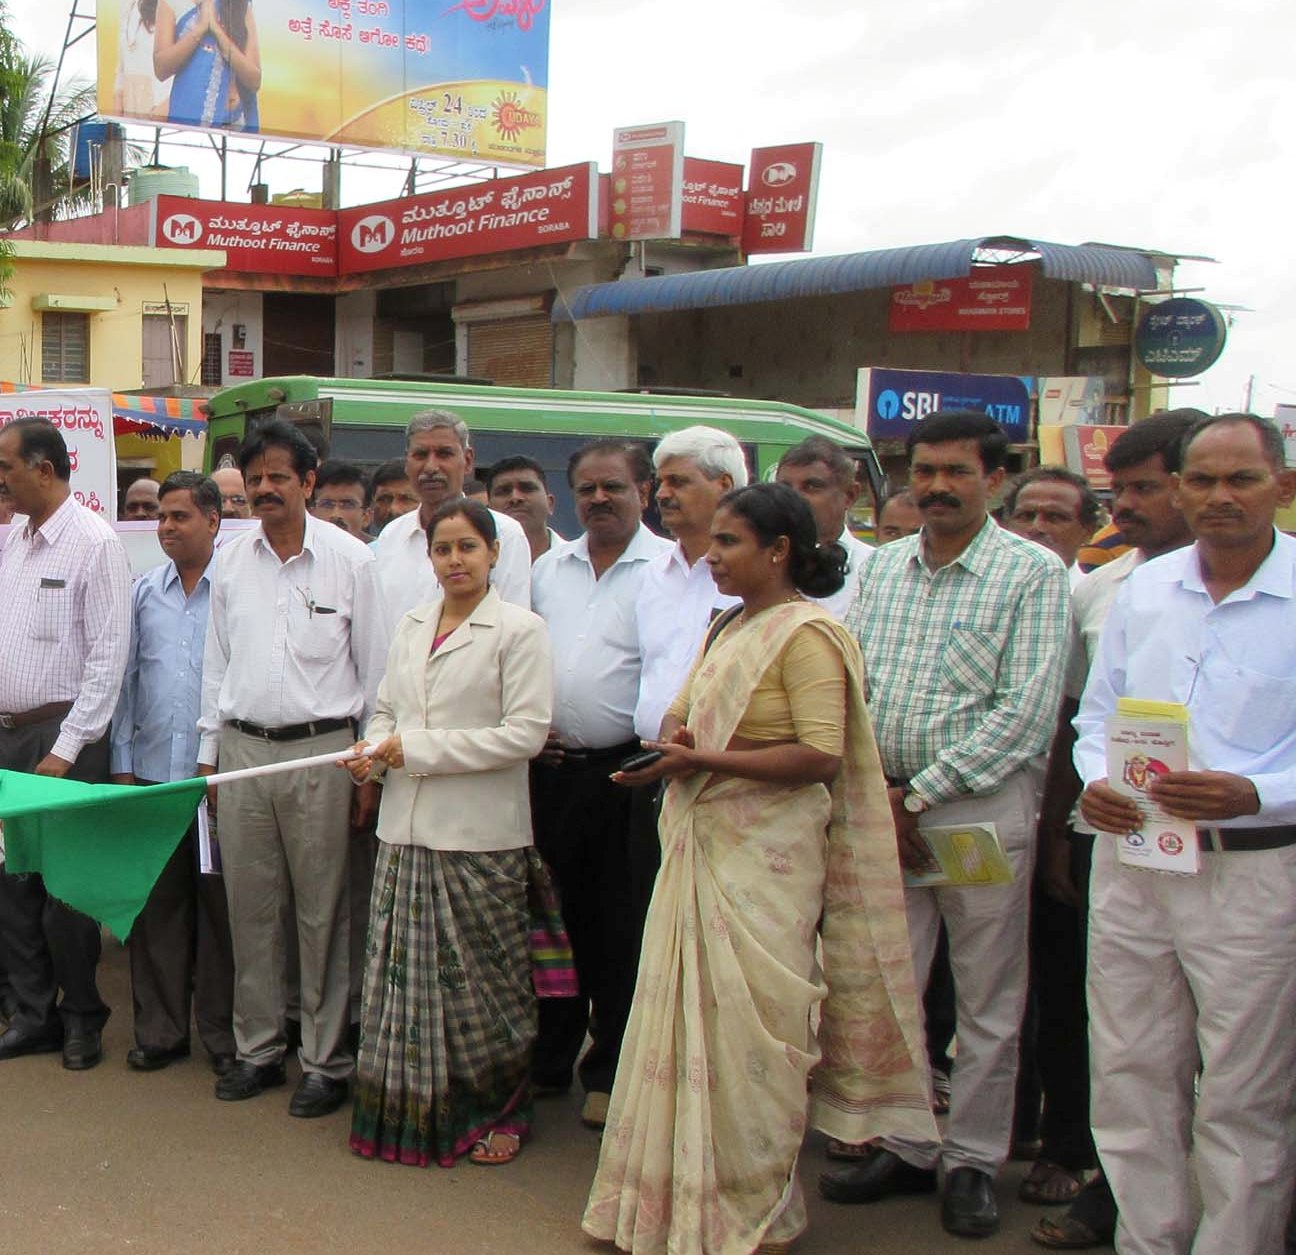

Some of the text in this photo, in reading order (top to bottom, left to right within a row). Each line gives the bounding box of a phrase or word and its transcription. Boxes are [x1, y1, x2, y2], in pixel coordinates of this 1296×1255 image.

[443, 93, 463, 115] 24
[697, 195, 729, 208] Finance
[400, 207, 550, 244] Muthoot Finance
[537, 222, 570, 235] SORABA
[207, 233, 321, 253] Muthoot Finance
[902, 391, 939, 420] SBI
[985, 403, 1021, 424] ATM
